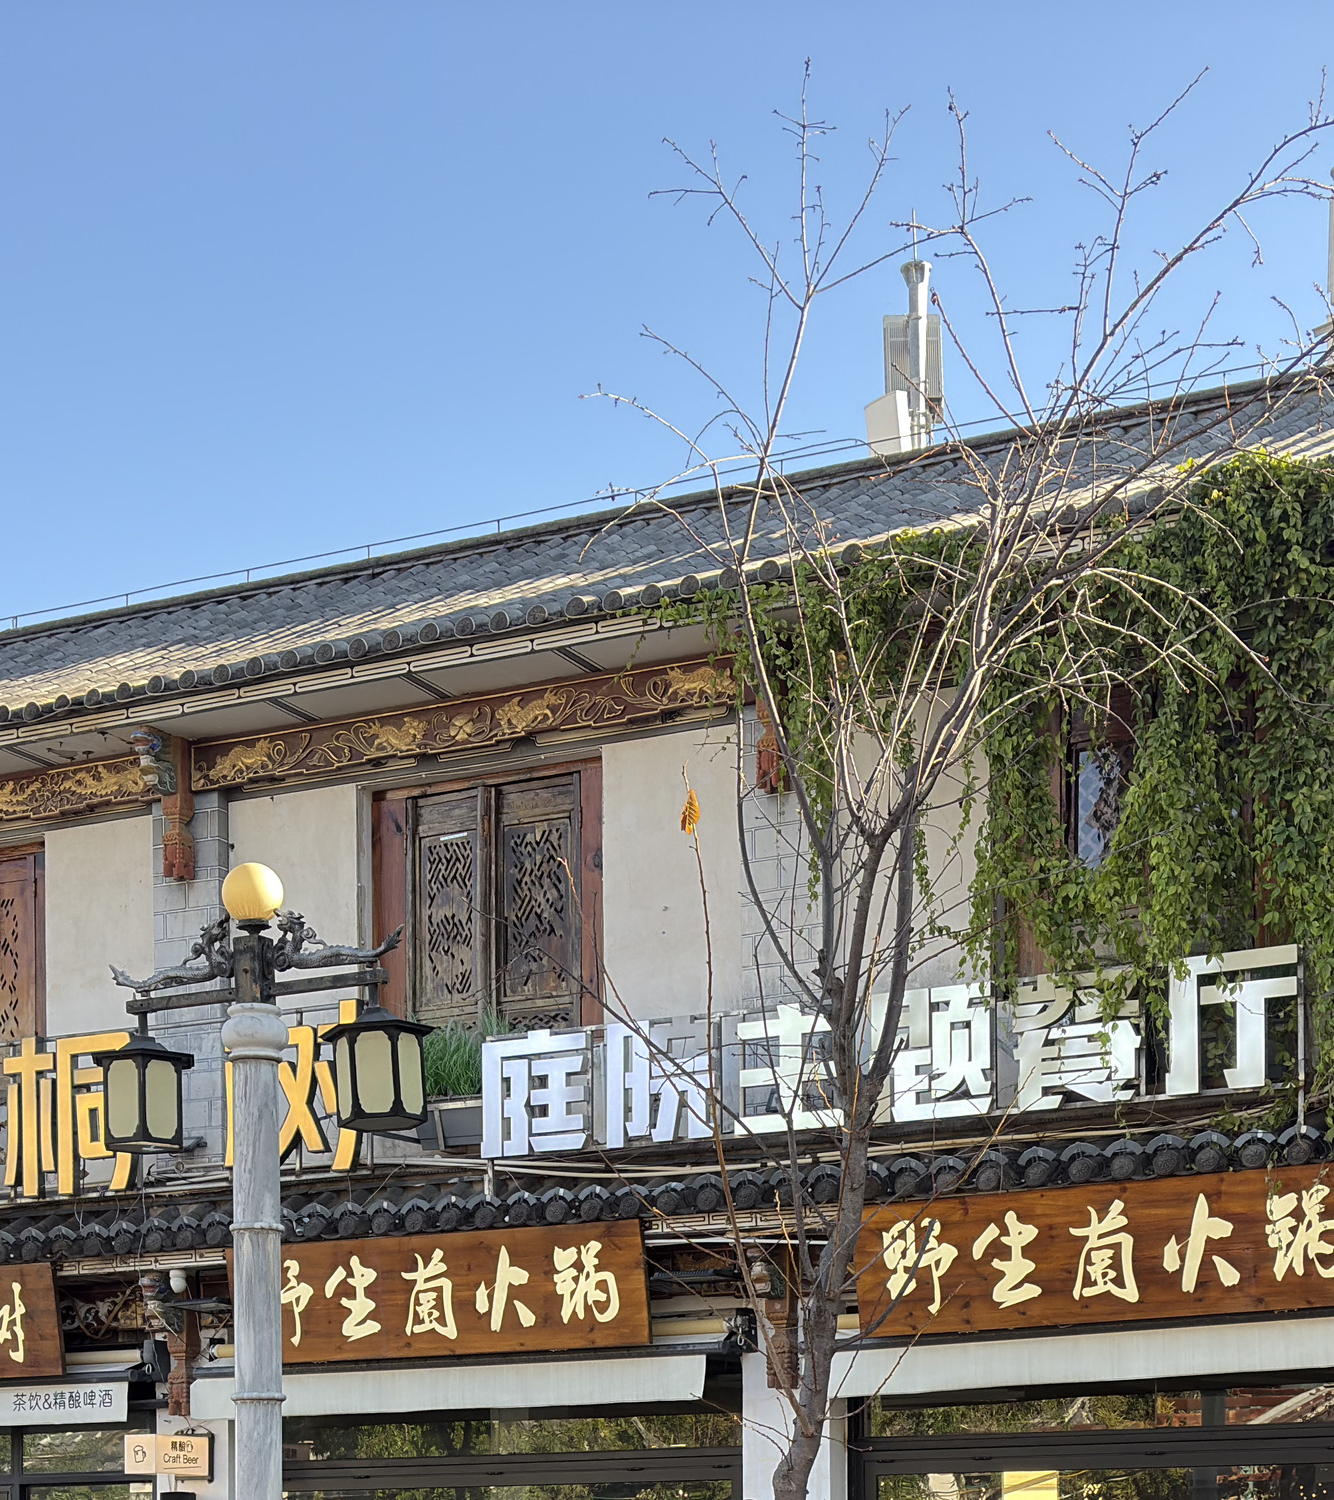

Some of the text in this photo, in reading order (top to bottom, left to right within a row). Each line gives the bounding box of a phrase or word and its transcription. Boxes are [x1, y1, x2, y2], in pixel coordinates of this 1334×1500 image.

[12, 1389, 114, 1412] 茶饮&精酿啤酒
[170, 1440, 186, 1452] 精酿
[163, 1453, 199, 1465] Craft Beer
